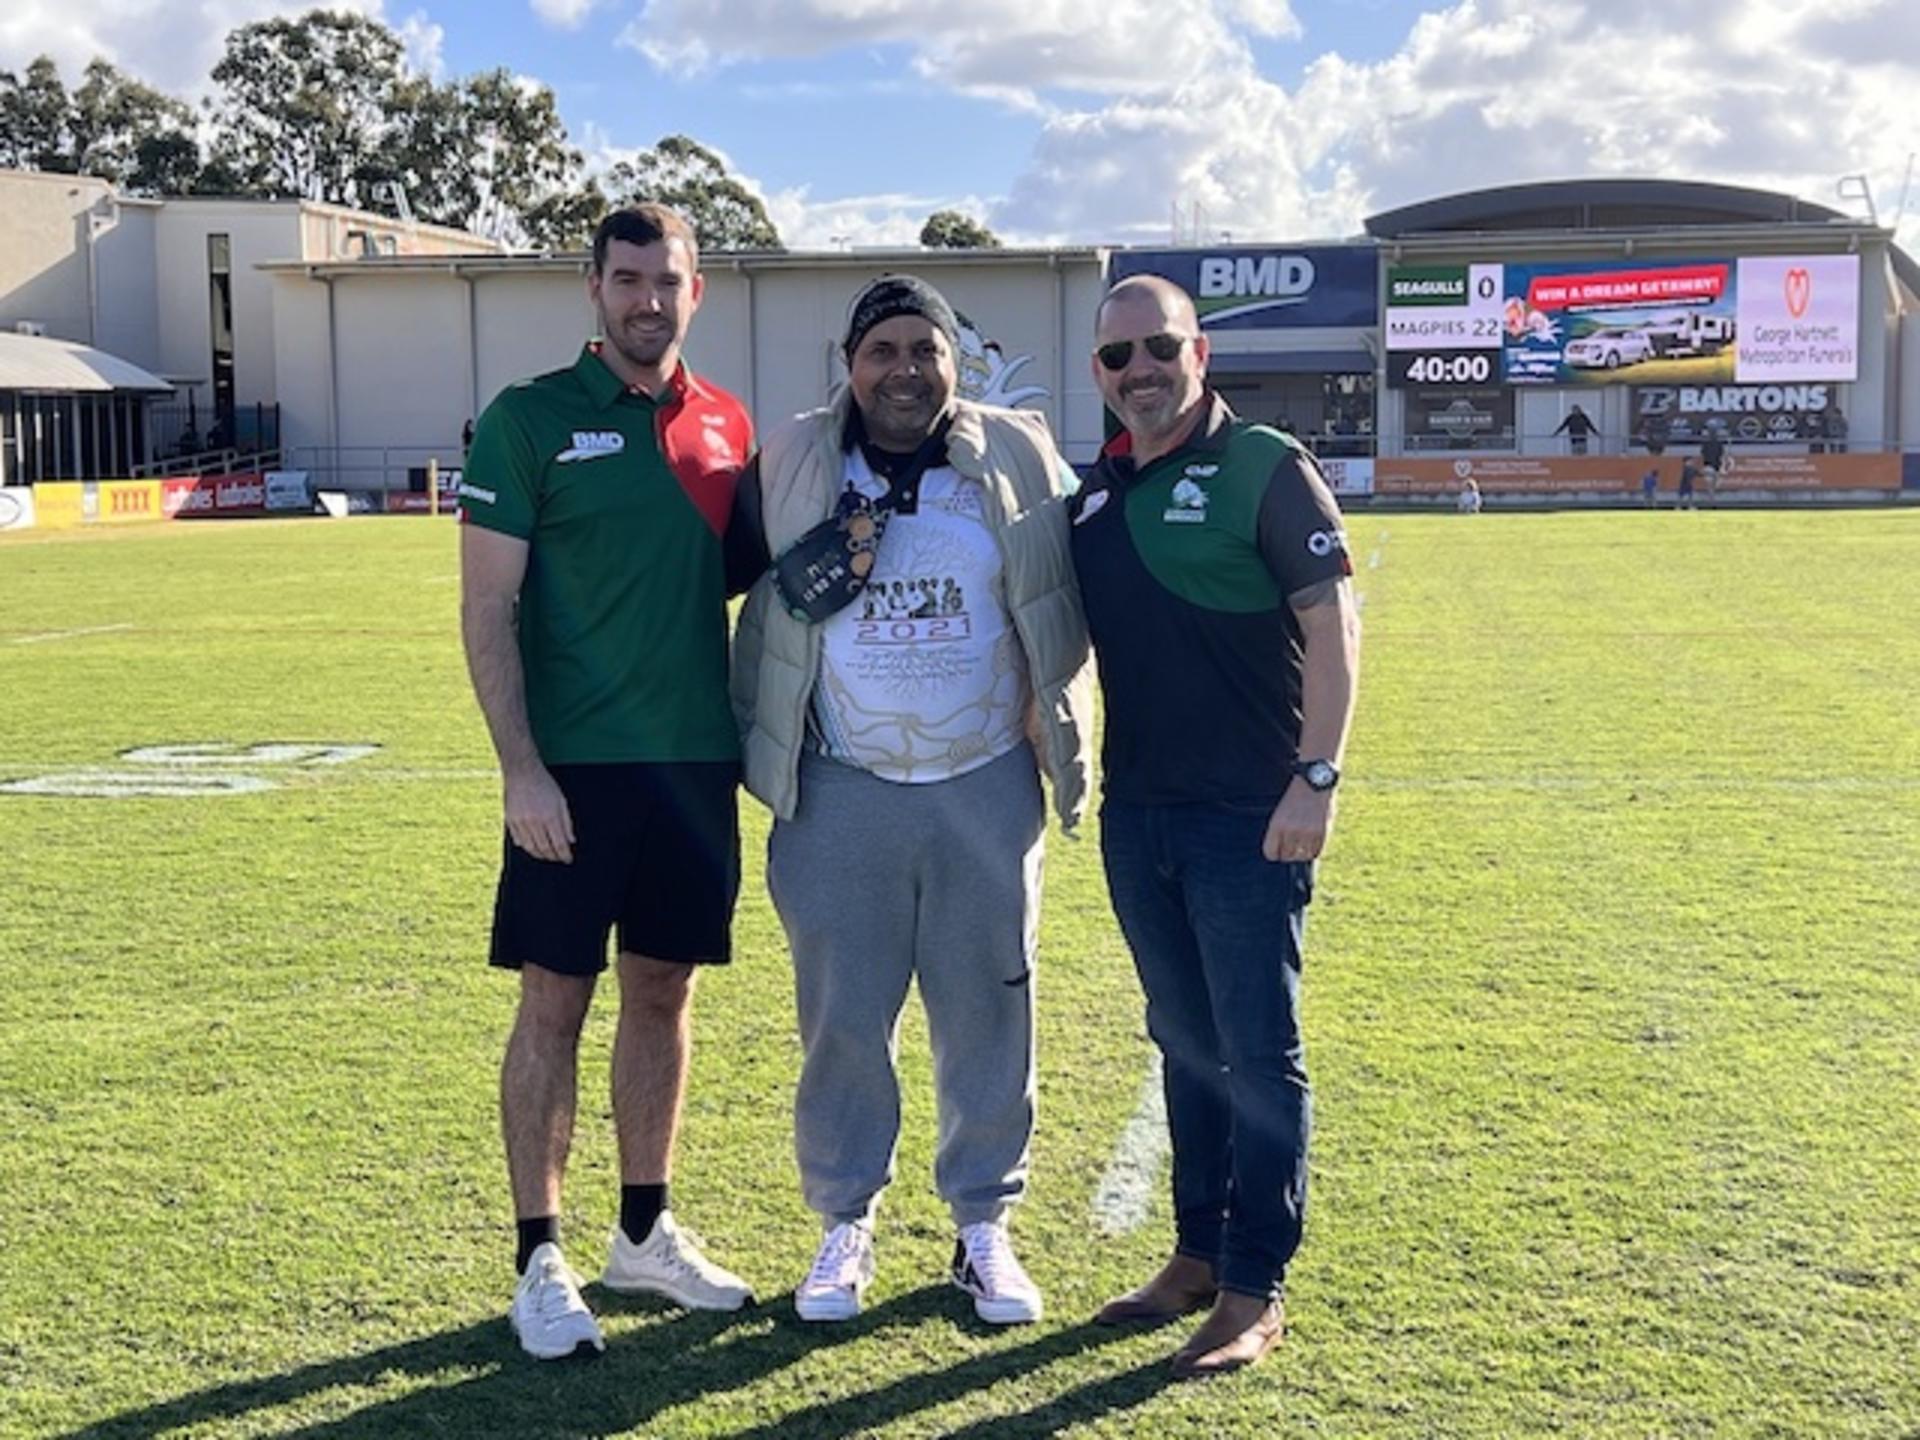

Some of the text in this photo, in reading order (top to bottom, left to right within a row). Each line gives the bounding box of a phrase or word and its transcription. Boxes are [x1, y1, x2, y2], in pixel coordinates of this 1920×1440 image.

[1200, 257, 1314, 297] BMD
[1393, 277, 1495, 298] SEAGULLS 0
[1535, 278, 1720, 300] WIN A DREAM GETAWAY!
[1391, 319, 1498, 336] MAGPIES 22
[1754, 325, 1791, 345] George
[1809, 346, 1852, 363] Funerals
[1407, 356, 1489, 381] 40:00
[1679, 386, 1827, 412] BARTONS
[573, 432, 625, 449] BMD
[111, 489, 149, 513] XXXX
[858, 617, 971, 639] 2021
